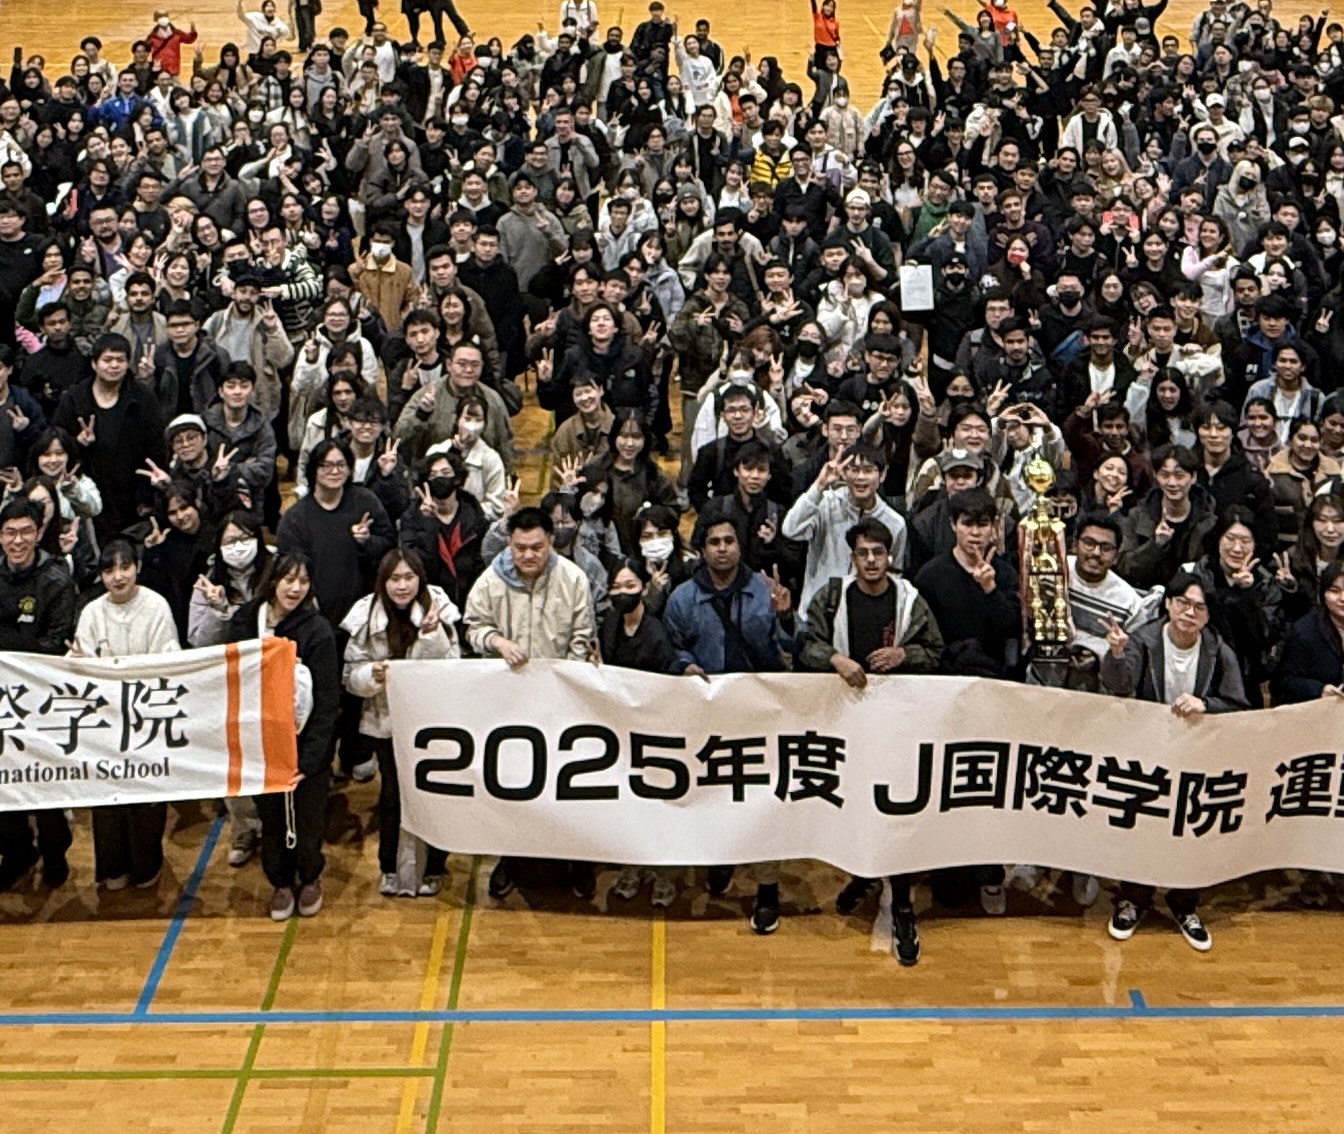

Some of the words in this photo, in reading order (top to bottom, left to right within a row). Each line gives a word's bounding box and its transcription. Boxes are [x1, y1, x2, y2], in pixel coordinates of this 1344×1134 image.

[96, 757, 170, 780] School
[414, 724, 846, 808] 2025年度
[873, 741, 1248, 837] J国際学院
